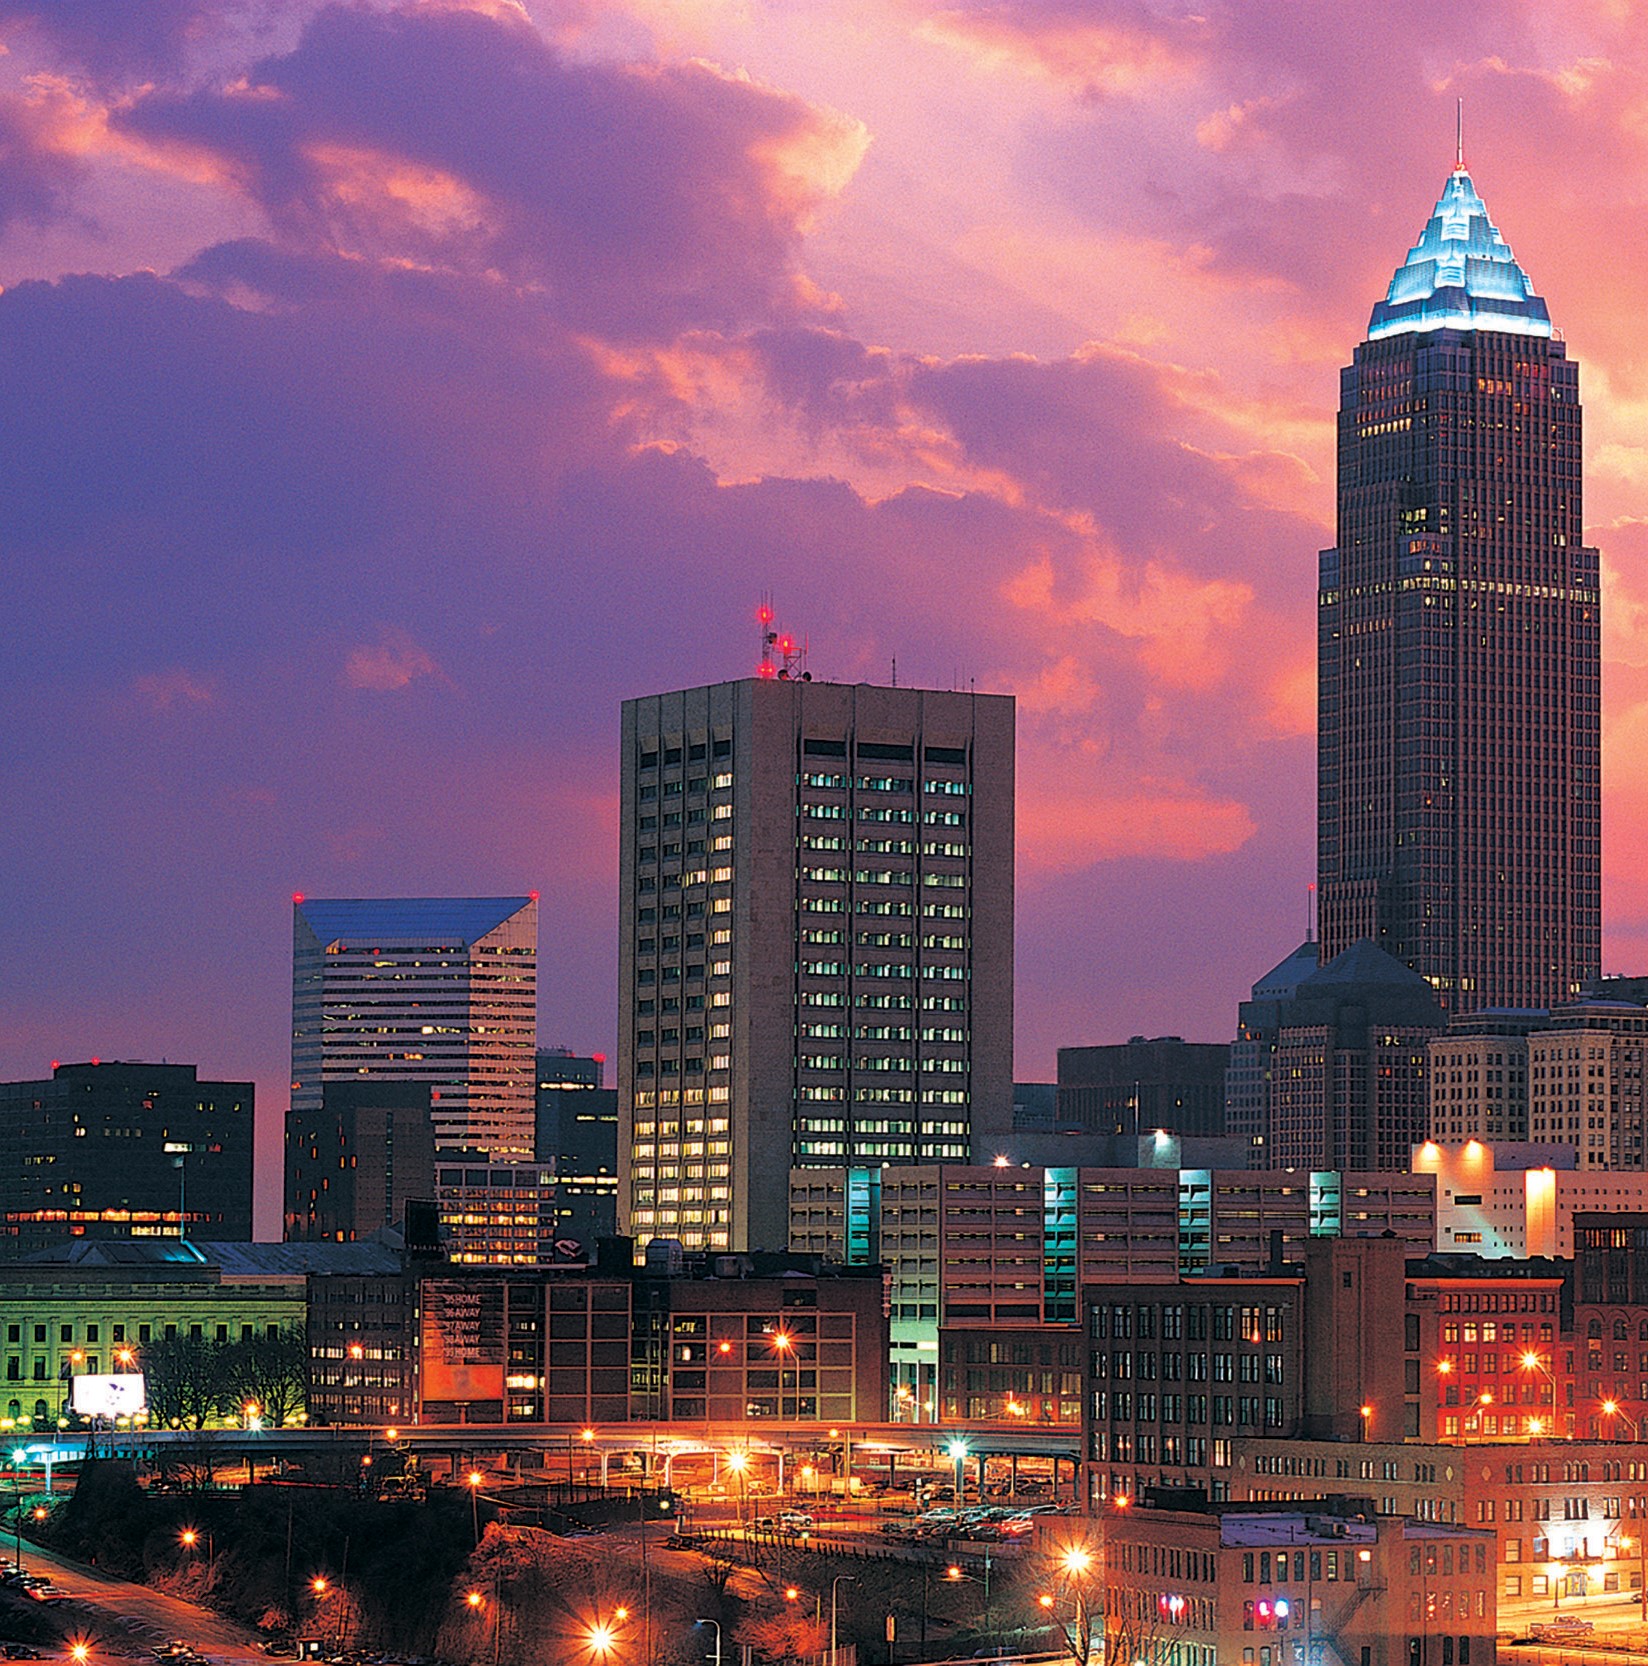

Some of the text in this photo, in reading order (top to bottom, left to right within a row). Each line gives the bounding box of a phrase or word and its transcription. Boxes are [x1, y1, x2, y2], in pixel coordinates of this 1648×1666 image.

[455, 1294, 482, 1304] HOME
[455, 1307, 481, 1317] AWAY
[455, 1321, 481, 1331] AWAY
[455, 1334, 481, 1344] AWAY
[455, 1347, 480, 1357] HOME
